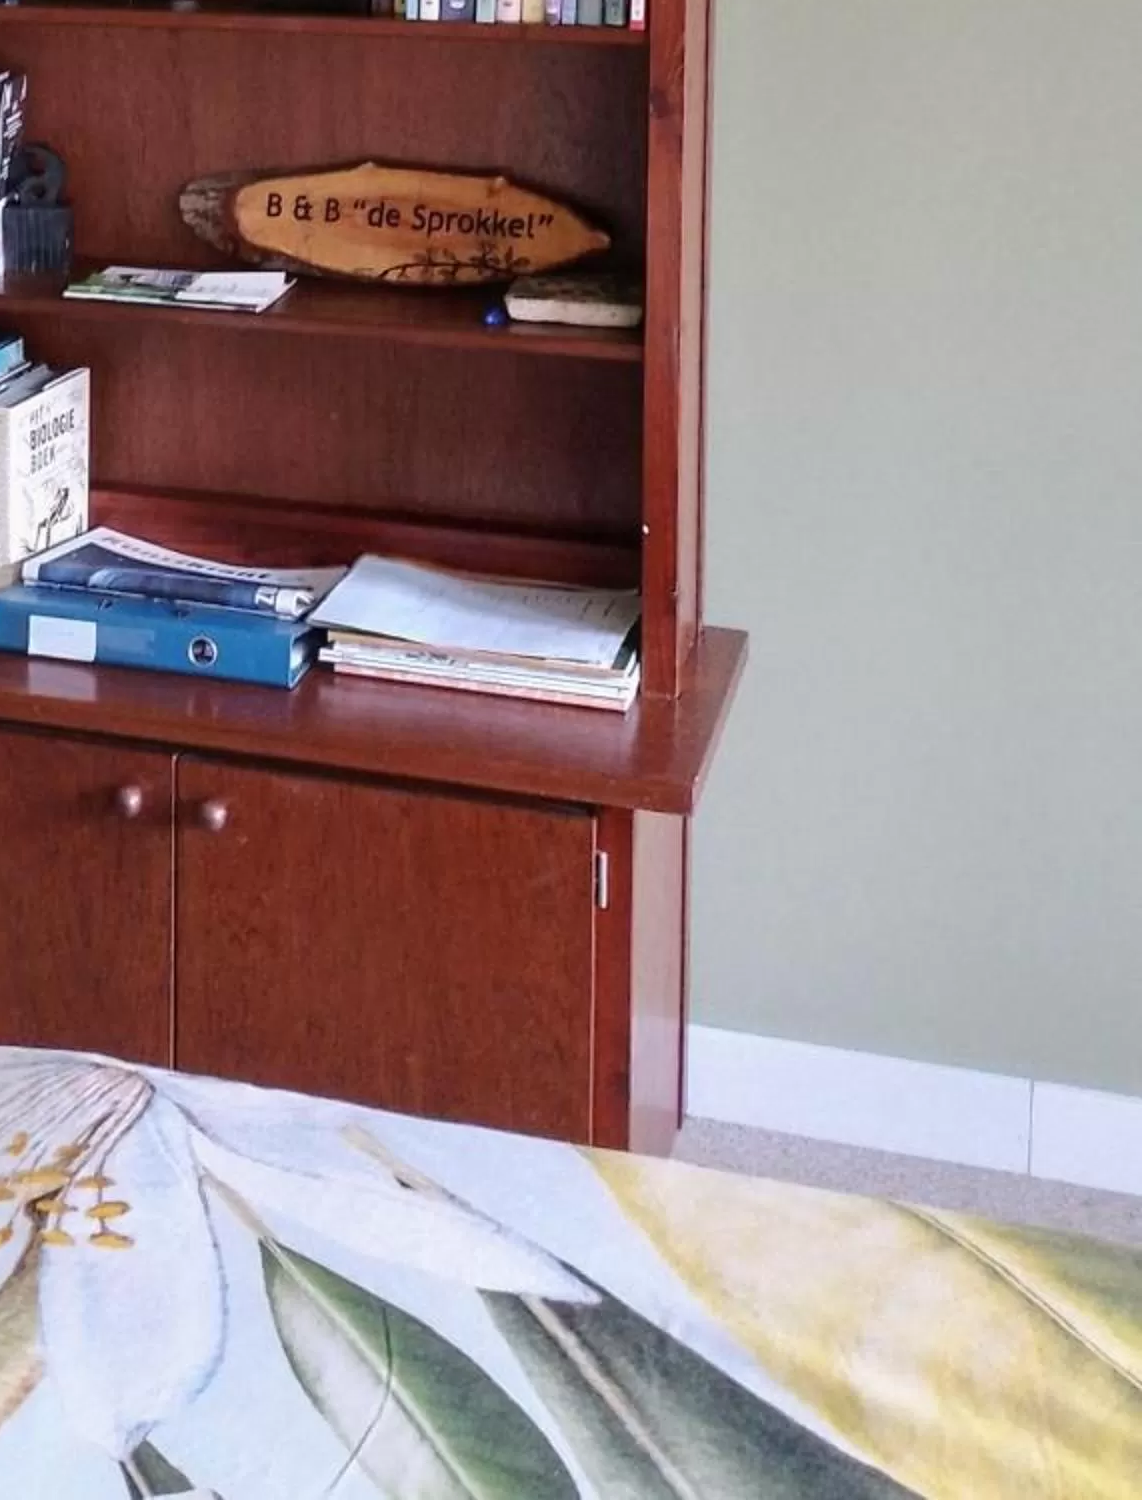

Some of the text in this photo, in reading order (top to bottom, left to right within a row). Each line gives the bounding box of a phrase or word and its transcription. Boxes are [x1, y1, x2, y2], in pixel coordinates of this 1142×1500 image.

[266, 193, 554, 239] B & B "de Sprokkel"
[29, 407, 75, 447] BIOLOGIE
